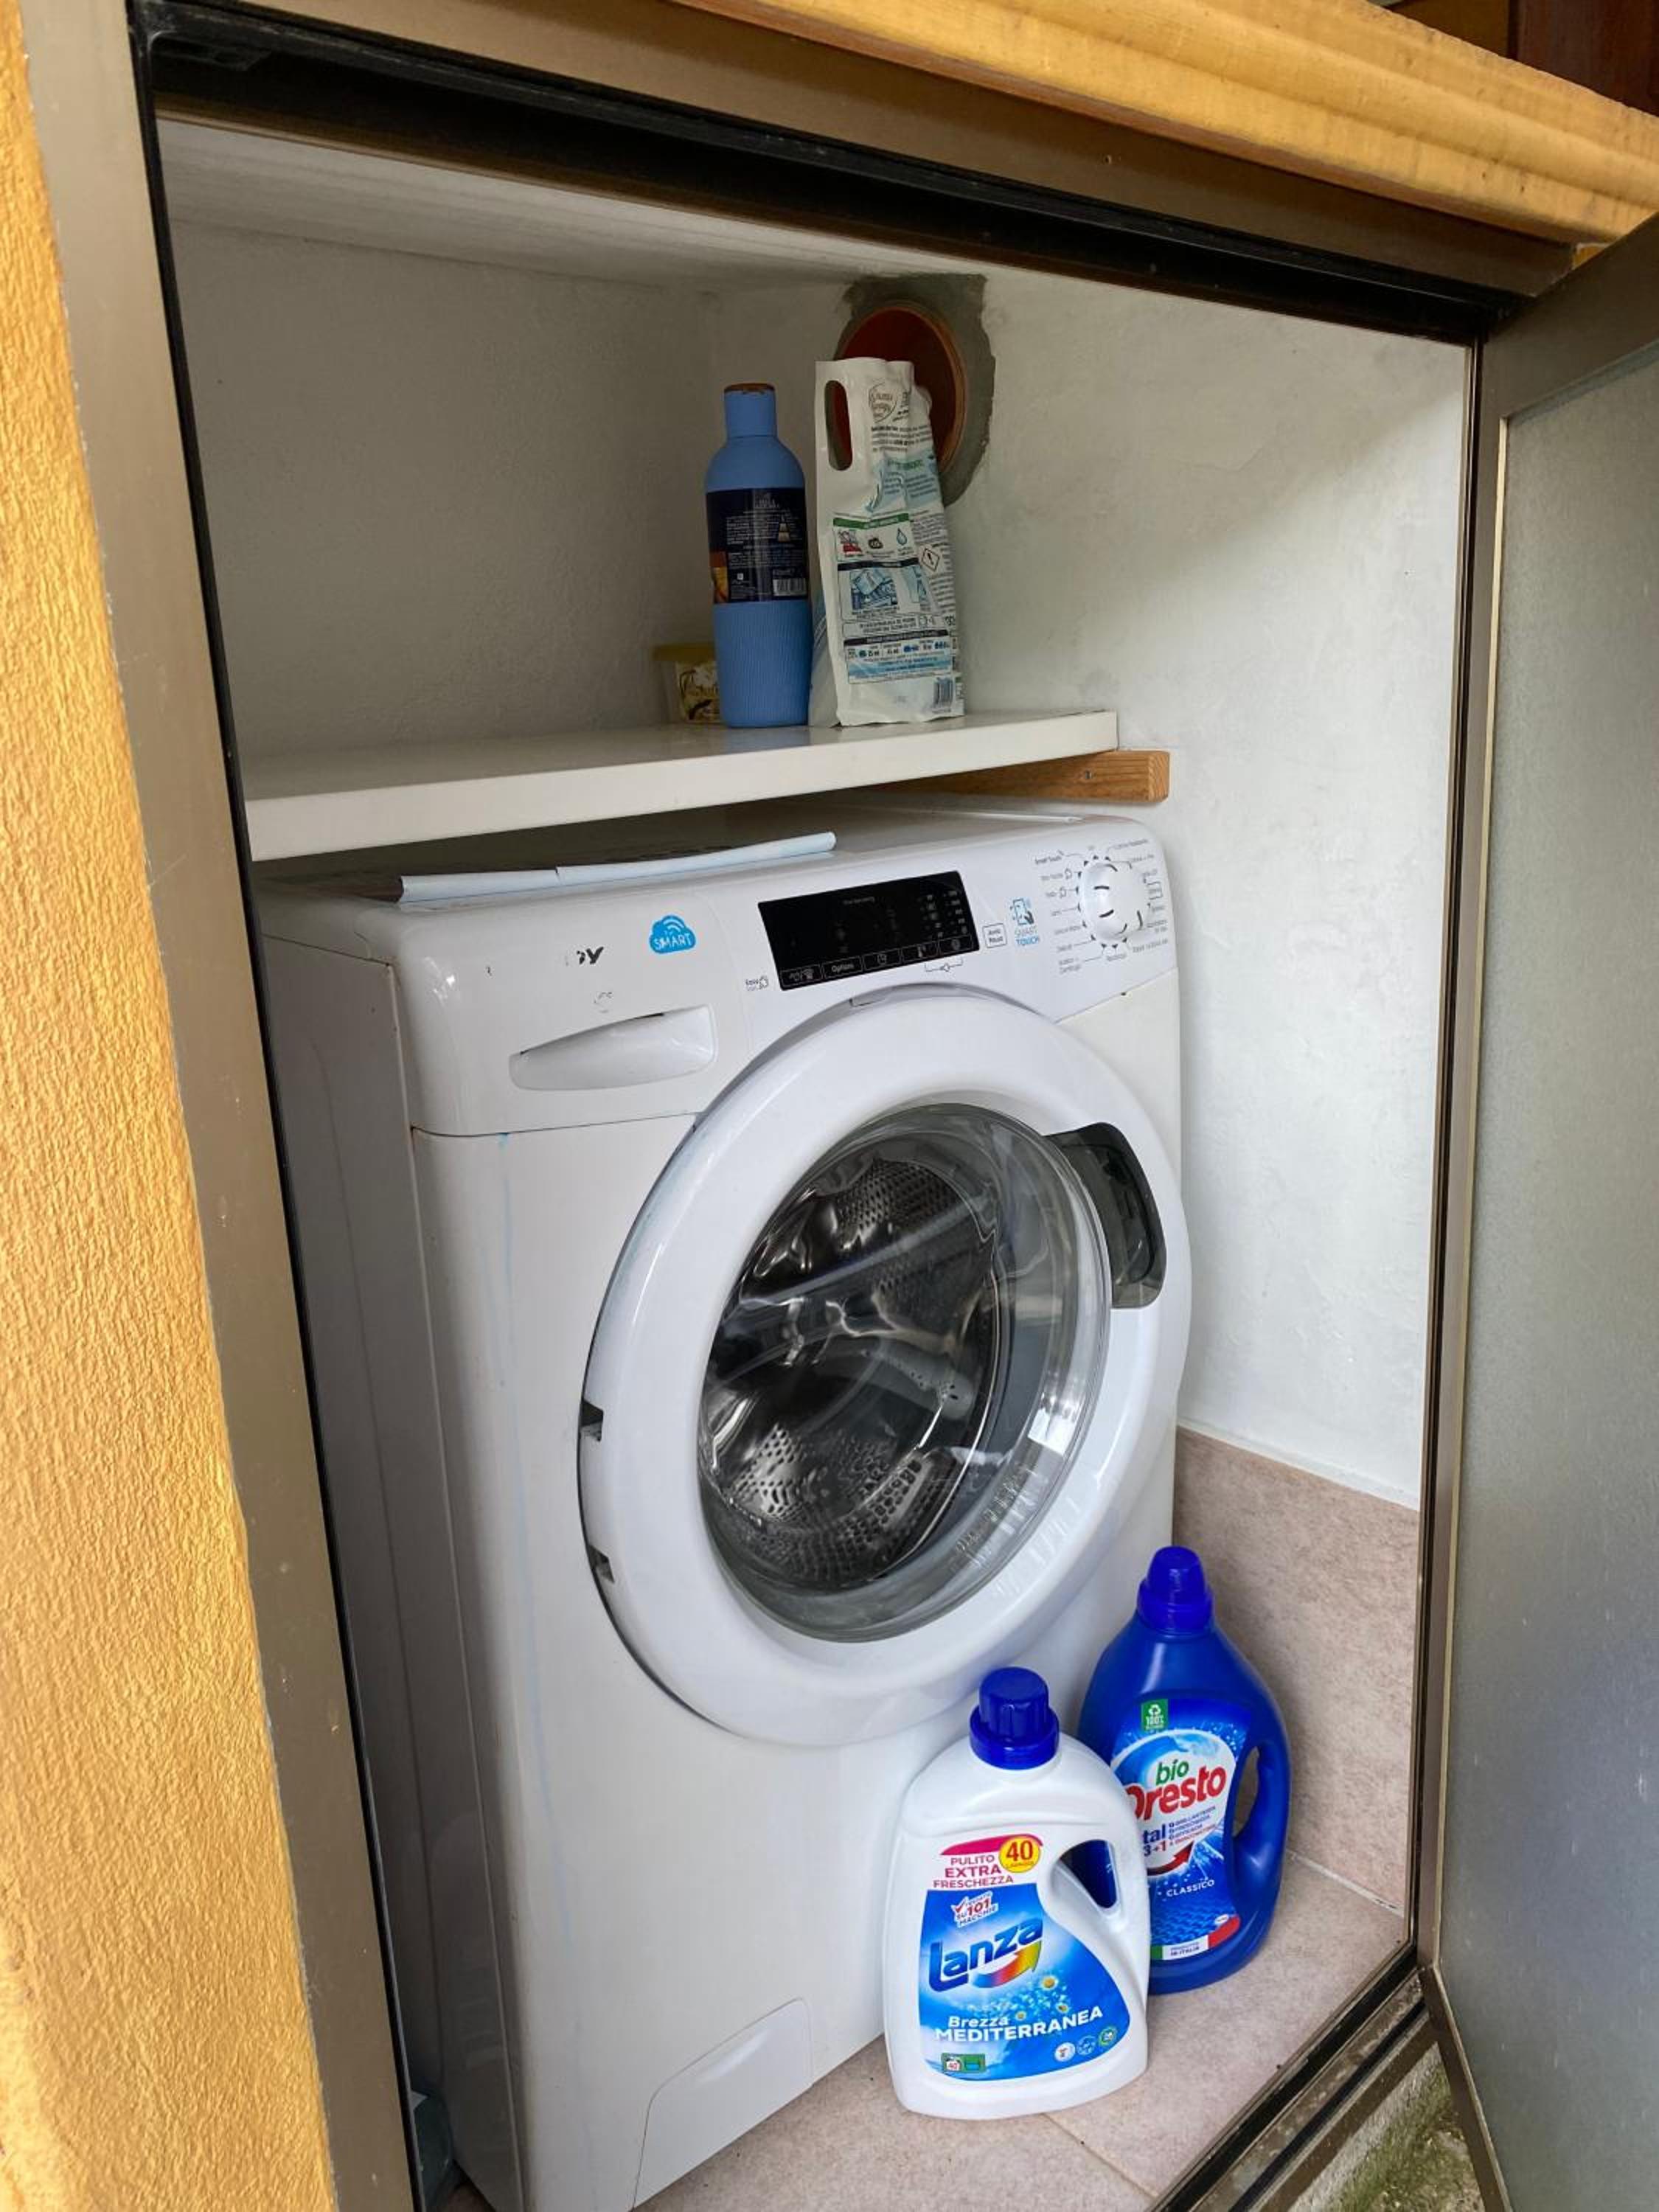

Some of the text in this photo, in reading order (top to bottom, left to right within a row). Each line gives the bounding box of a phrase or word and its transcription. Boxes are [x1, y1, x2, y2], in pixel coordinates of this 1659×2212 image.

[655, 933, 692, 950] SMART
[1155, 1759, 1189, 1786] bio
[1143, 1823, 1166, 1844] tal
[950, 1854, 995, 1866] PULITO
[1006, 1840, 1034, 1862] 40
[945, 1863, 1002, 1878] EXTRA
[933, 1874, 1014, 1888] FRESCHEZZA
[1166, 1879, 1215, 1897] CLASSICO
[959, 1907, 997, 1925] MACCHIE
[967, 1898, 990, 1916] 101
[928, 1919, 1043, 1992] Lanza
[934, 2006, 1104, 2043] MEDITERRANEA
[947, 2016, 1009, 2028] Brezza
